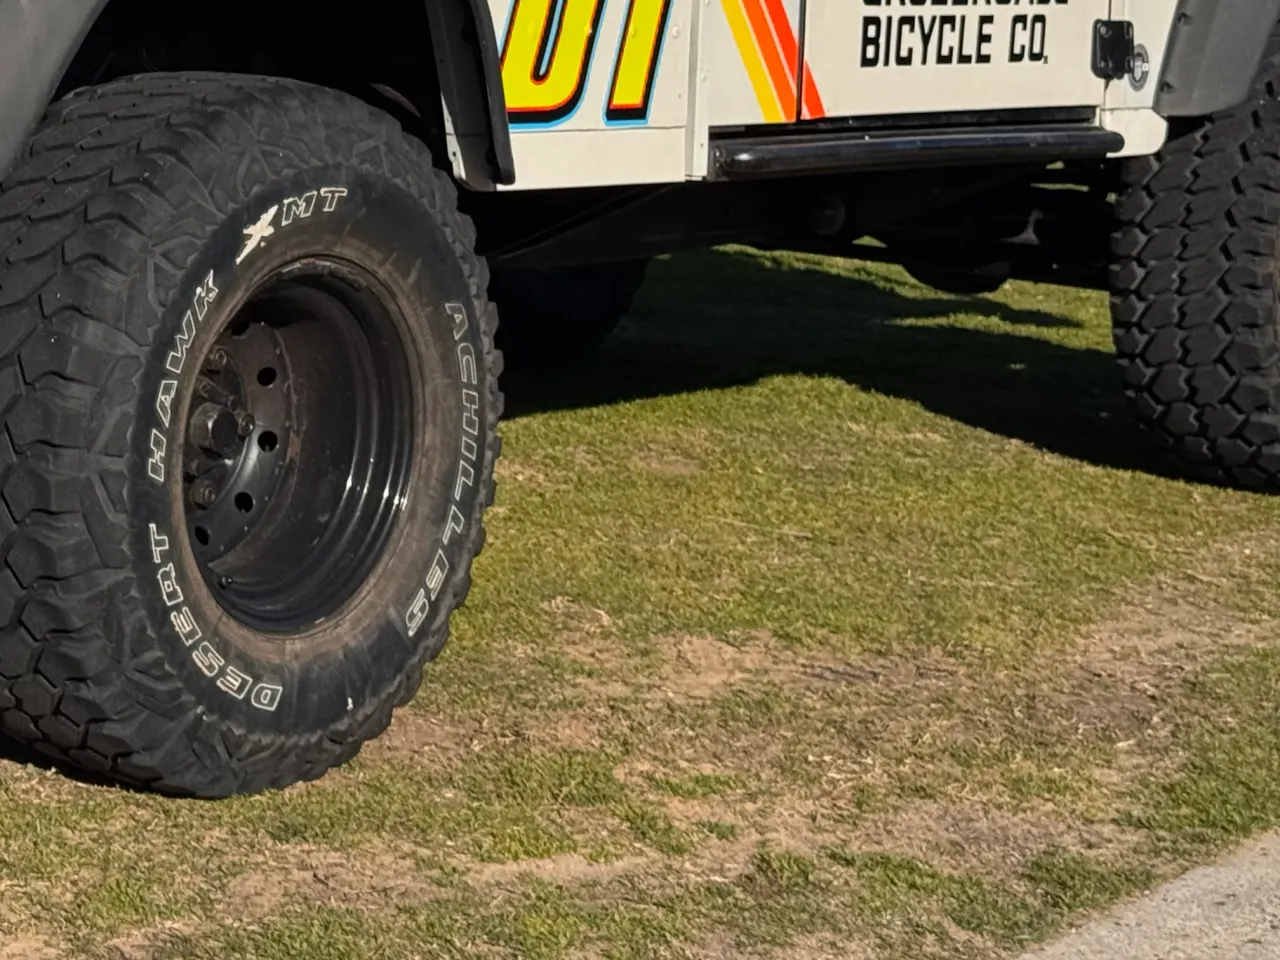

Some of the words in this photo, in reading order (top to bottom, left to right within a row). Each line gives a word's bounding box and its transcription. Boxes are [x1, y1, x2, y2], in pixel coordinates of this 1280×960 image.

[859, 14, 995, 68] BICYCLE
[147, 268, 220, 483] HAWK
[405, 302, 479, 637] ACHILLES
[148, 522, 283, 711] DESERT
